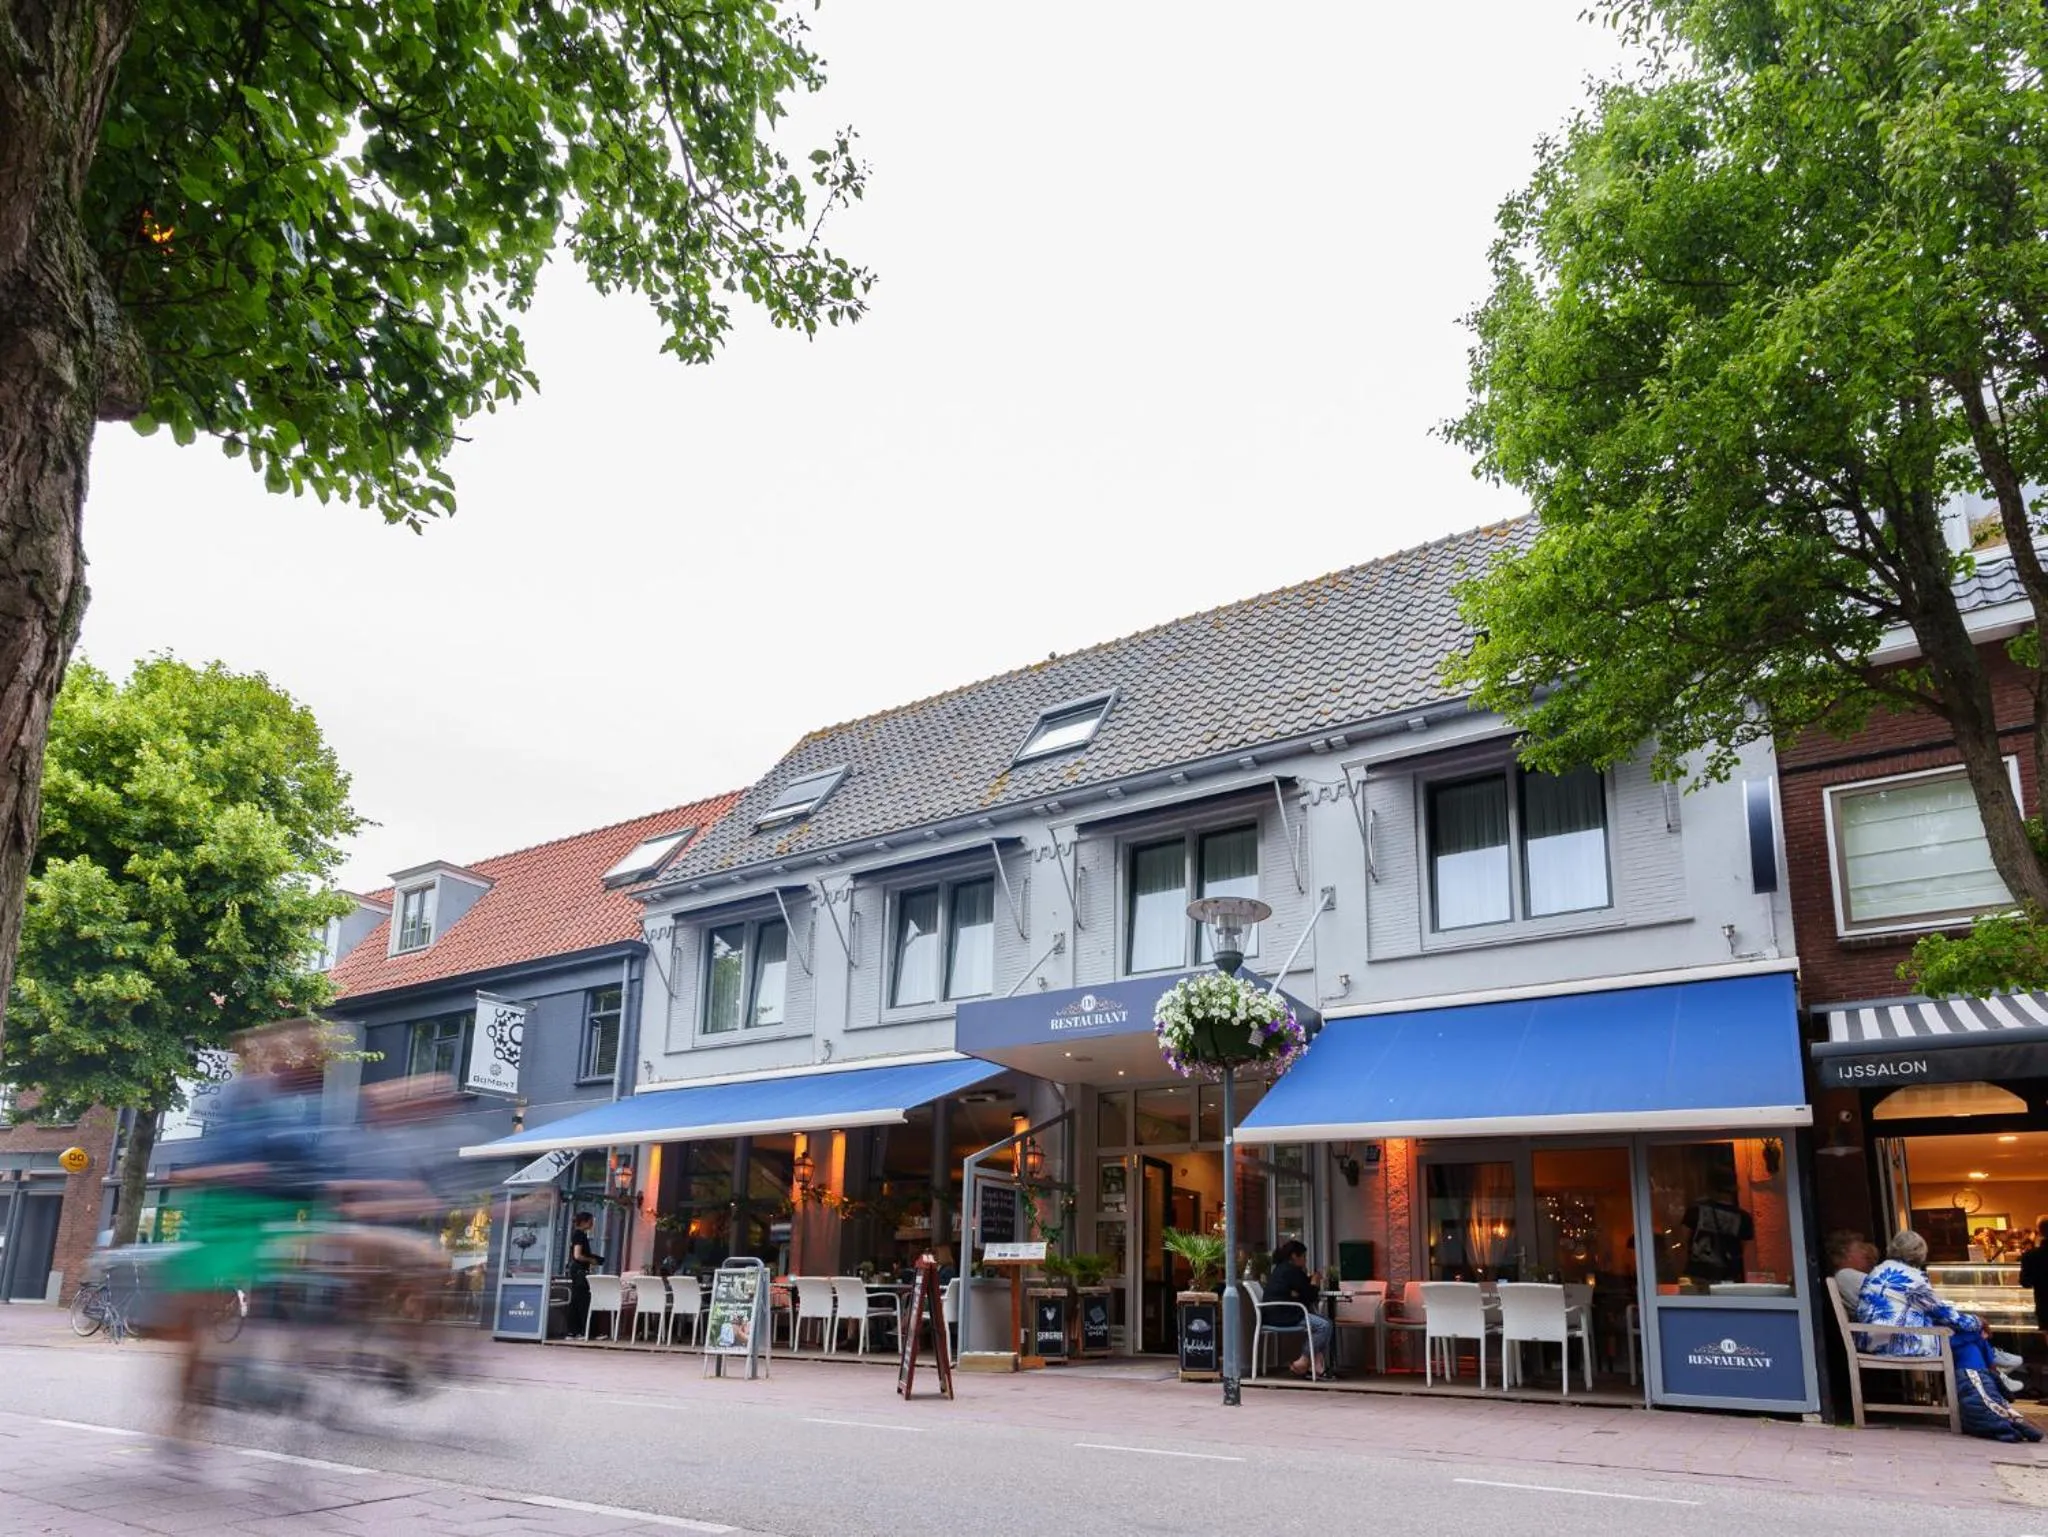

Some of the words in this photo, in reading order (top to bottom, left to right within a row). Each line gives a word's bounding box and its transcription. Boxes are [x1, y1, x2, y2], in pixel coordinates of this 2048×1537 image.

[1050, 1011, 1129, 1030] RESTAURANT
[1838, 1060, 1928, 1079] IJSSALON
[1688, 1354, 1773, 1368] RESTAURANT
